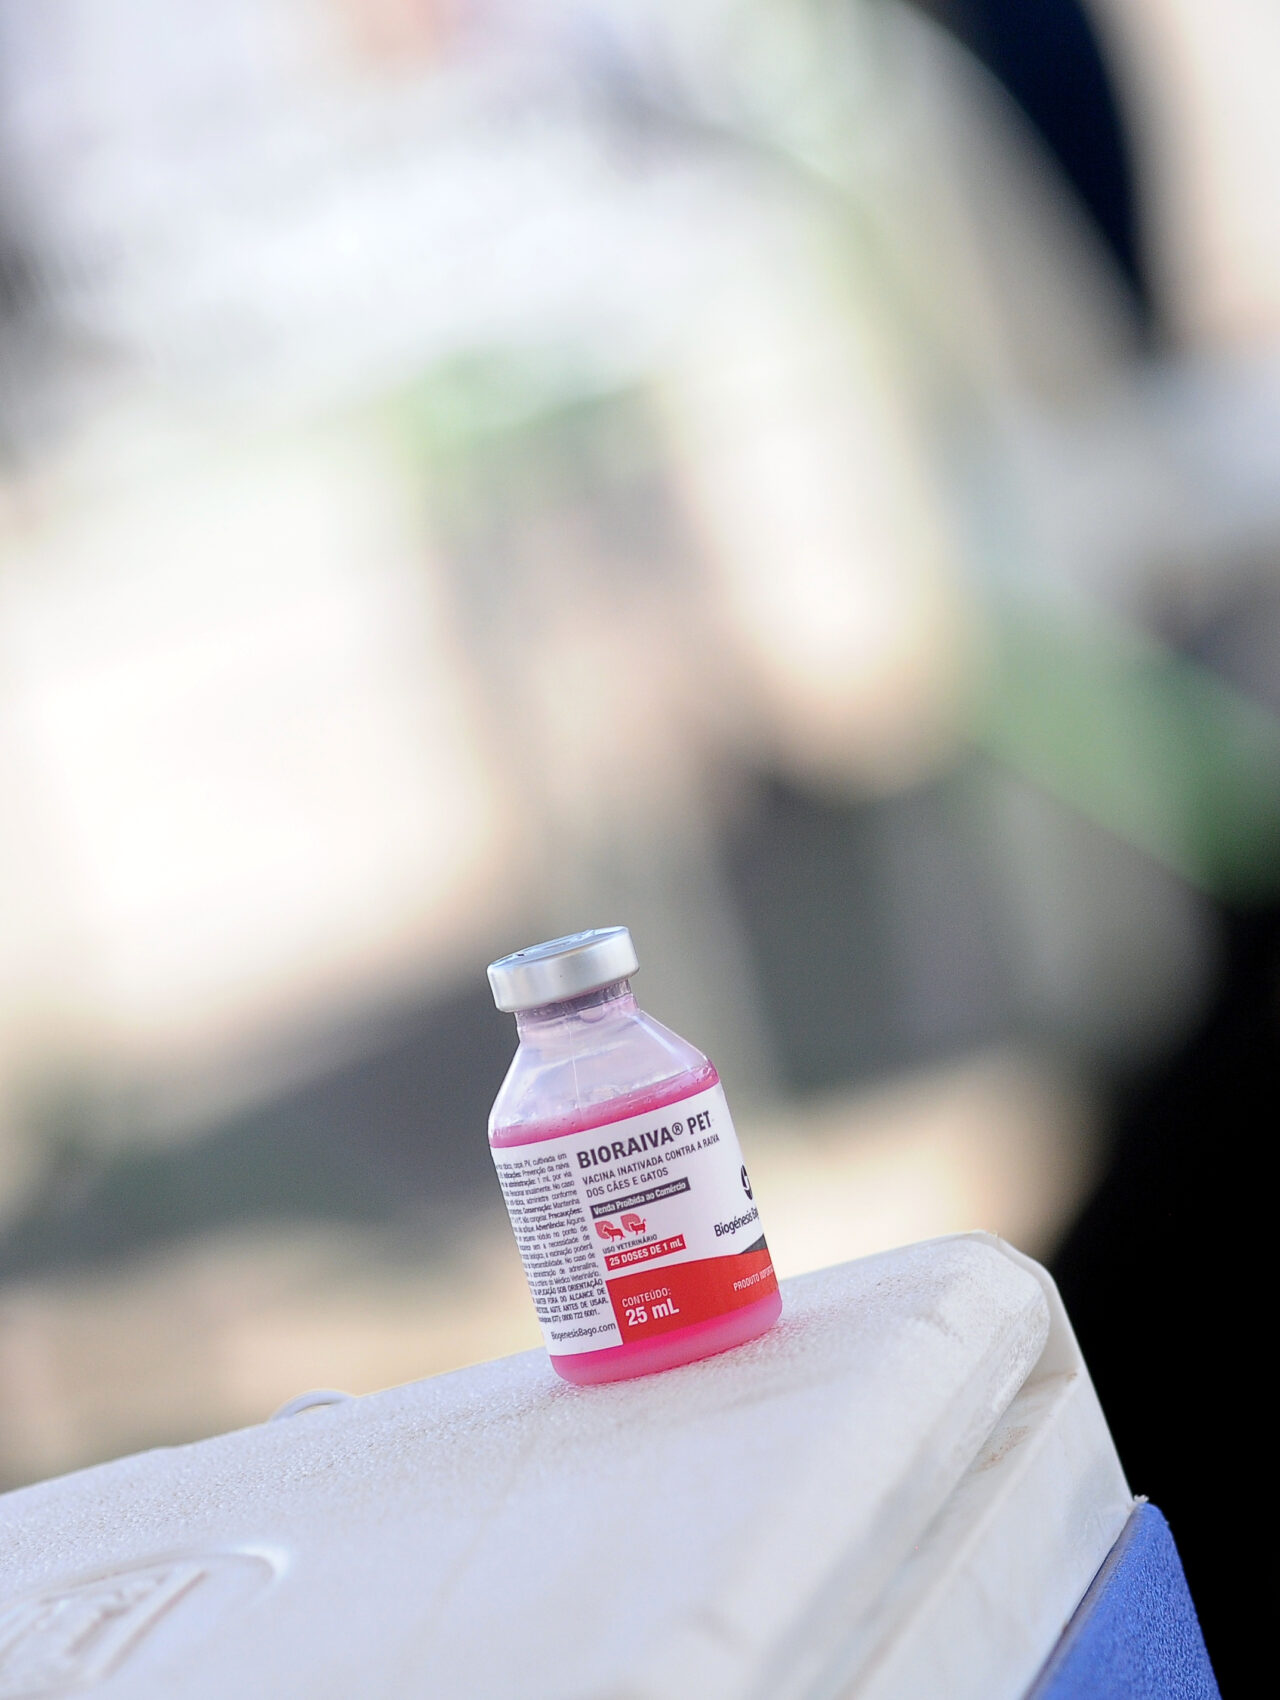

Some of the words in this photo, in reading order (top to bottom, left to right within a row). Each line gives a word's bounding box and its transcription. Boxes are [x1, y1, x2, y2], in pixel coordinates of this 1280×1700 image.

[687, 1111, 711, 1135] PET
[583, 1170, 616, 1185] VACINA
[618, 1156, 663, 1176] INATIVADA
[665, 1144, 696, 1161] CONTRA
[698, 1141, 702, 1150] A
[703, 1134, 720, 1147] RAIVA
[586, 1186, 605, 1198] DOS
[607, 1179, 630, 1192] CÃES
[632, 1177, 638, 1185] E
[640, 1168, 668, 1183] GATOS
[594, 1204, 616, 1215] Venda
[616, 1196, 645, 1209] Proibida
[655, 1183, 686, 1197] Comércio
[714, 1210, 753, 1236] Biogénesis
[603, 1246, 616, 1254] USO
[617, 1234, 657, 1250] VETERINÁRIO
[610, 1256, 620, 1266] 25
[621, 1249, 649, 1263] DOSES
[650, 1245, 662, 1255] DE
[670, 1239, 683, 1249] mL
[733, 1273, 760, 1290] PRODUTO
[563, 1303, 579, 1311] ANTES
[570, 1290, 594, 1301] ALCANCE
[622, 1288, 671, 1307] CONTEÚDO:
[626, 1307, 648, 1326] 25
[652, 1299, 679, 1319] mL
